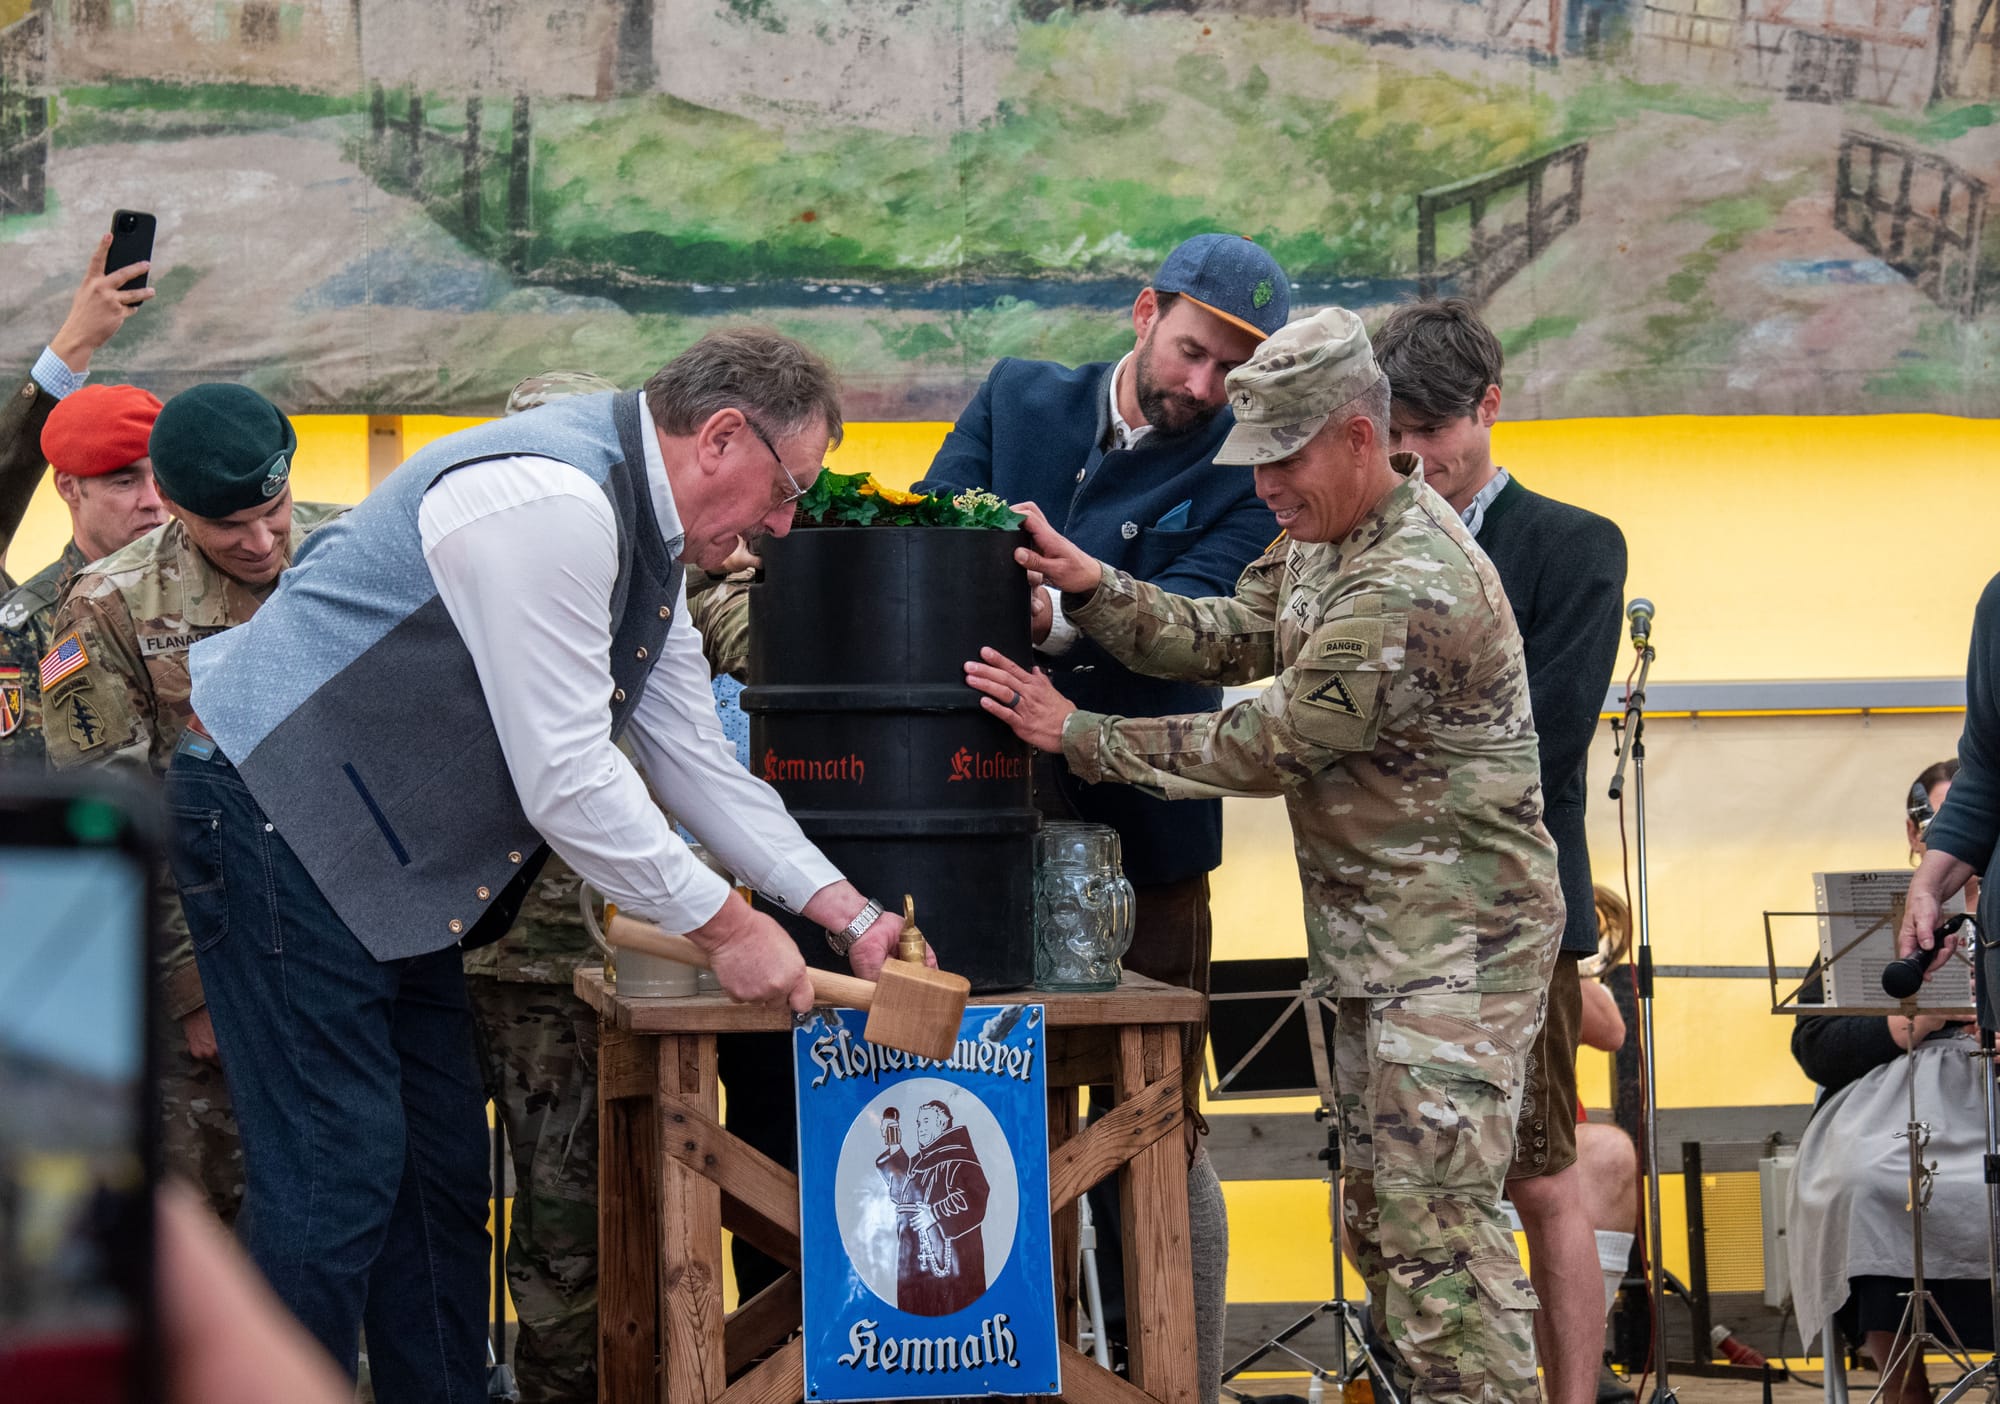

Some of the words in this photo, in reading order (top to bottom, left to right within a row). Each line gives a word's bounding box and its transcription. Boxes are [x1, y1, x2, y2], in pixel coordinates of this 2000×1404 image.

[1326, 641, 1363, 653] RANGER
[763, 747, 865, 785] Kemnath
[810, 1029, 1034, 1088] Klosterauerei
[836, 1312, 1020, 1374] Kemnath
